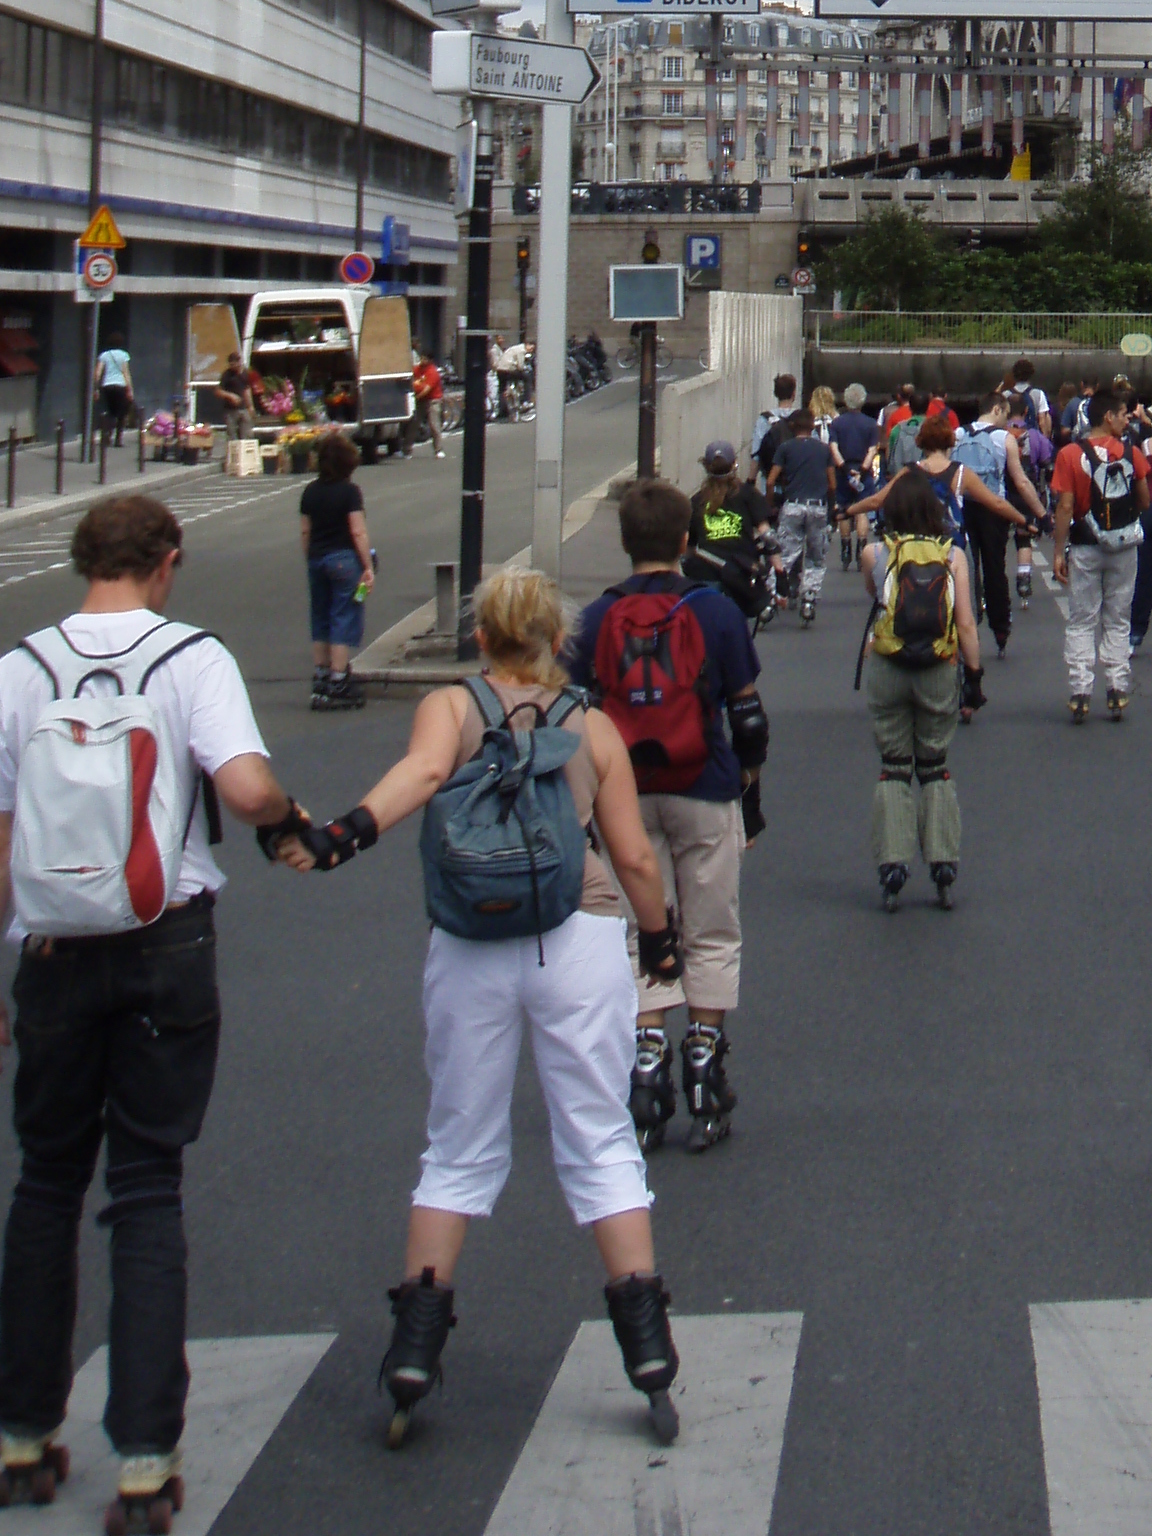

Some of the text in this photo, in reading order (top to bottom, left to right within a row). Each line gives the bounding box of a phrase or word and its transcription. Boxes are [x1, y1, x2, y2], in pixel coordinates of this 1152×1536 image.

[476, 44, 530, 70] Faubourg
[476, 67, 563, 93] Saint ANTOINE
